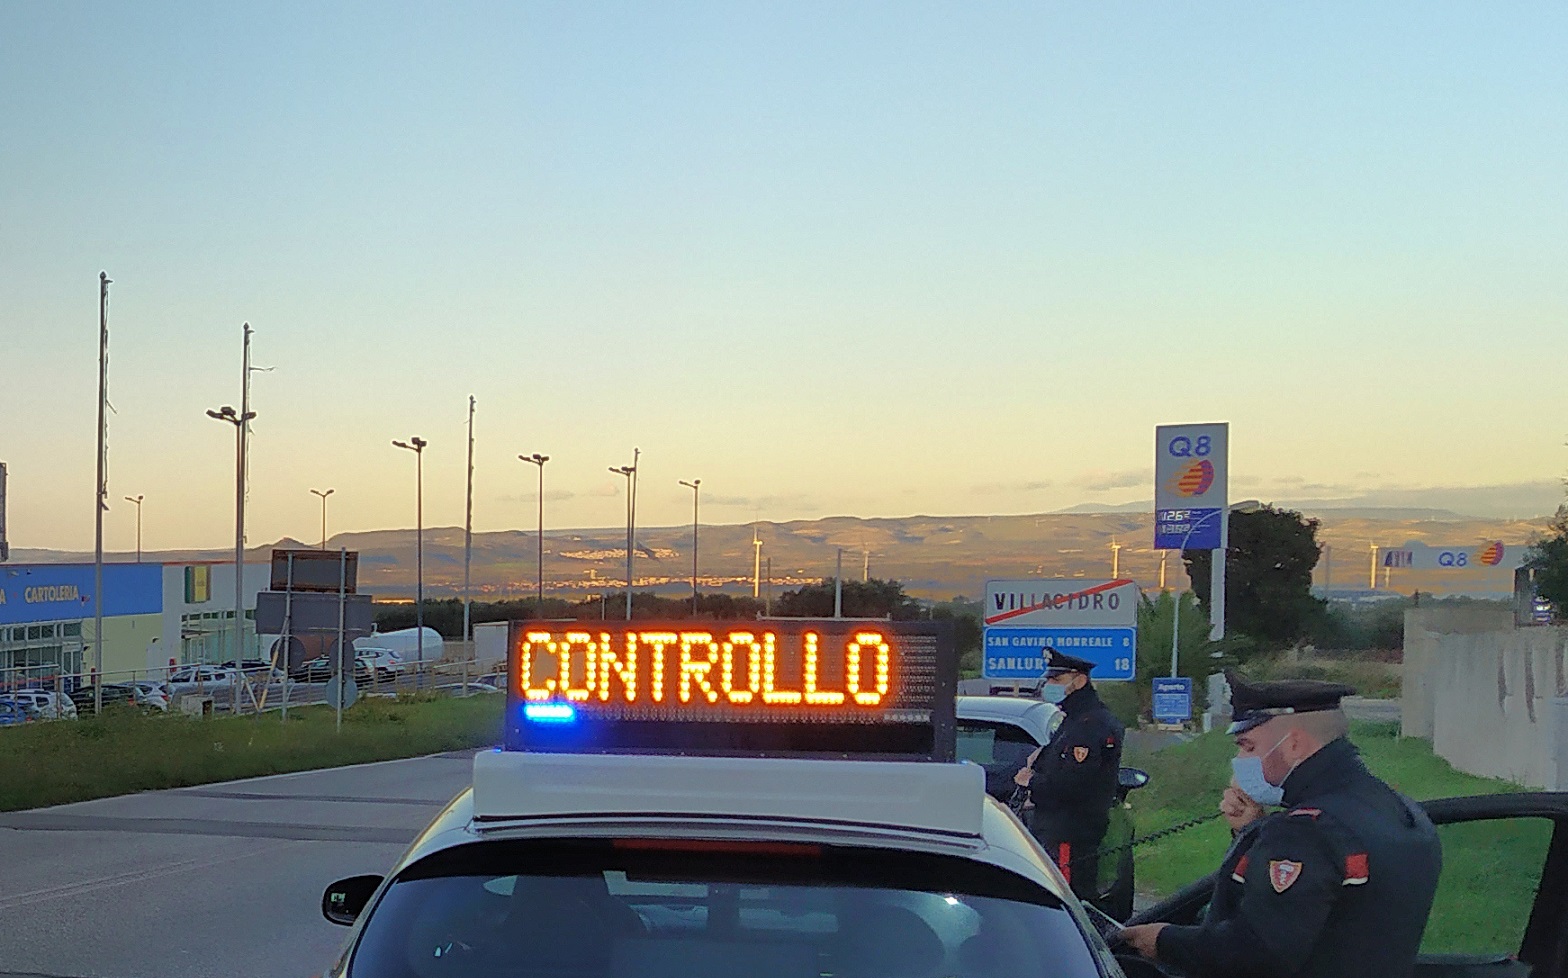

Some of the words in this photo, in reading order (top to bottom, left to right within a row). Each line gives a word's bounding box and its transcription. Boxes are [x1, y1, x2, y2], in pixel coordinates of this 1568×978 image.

[1169, 435, 1211, 457] Q8
[1438, 552, 1467, 567] Q8
[24, 585, 79, 604] CARTOLERIA
[994, 592, 1121, 611] VILLACIDRO
[988, 637, 1009, 647] SAN
[1012, 637, 1054, 647] GAVINO
[1057, 637, 1113, 648] MONREALE
[520, 630, 890, 706] CONTROLLO
[988, 657, 1043, 670] SANLUR
[1114, 658, 1130, 671] 18
